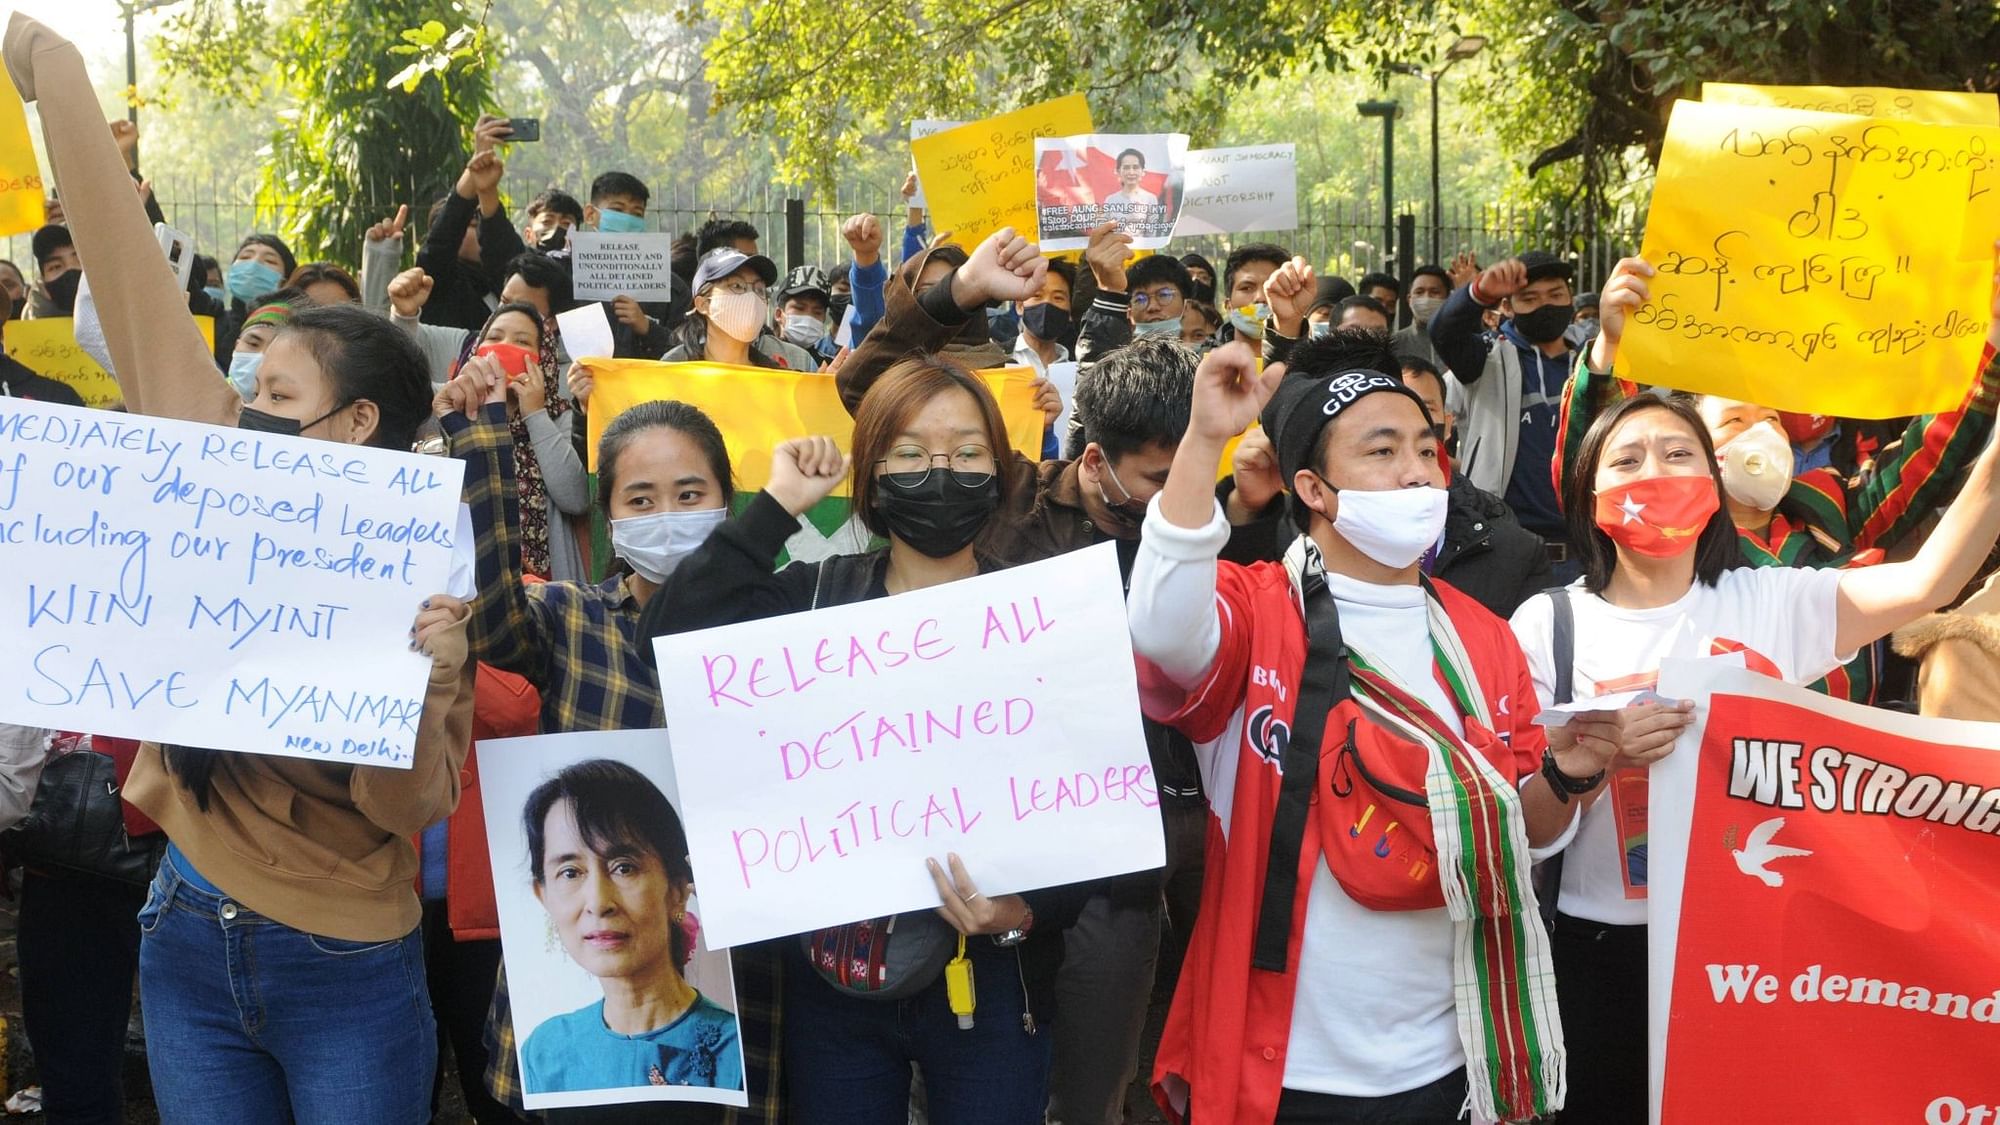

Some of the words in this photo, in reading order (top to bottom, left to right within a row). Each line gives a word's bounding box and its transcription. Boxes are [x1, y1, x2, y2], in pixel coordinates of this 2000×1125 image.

[600, 243, 640, 251] RELEASE
[577, 282, 625, 290] POLITICAL
[626, 282, 667, 290] LEADERS
[1322, 377, 1397, 415] GUCCI
[0, 453, 26, 510] f
[54, 461, 121, 495] our
[153, 467, 323, 533] deposed
[201, 433, 370, 484] RELEASE
[388, 467, 442, 495] ALL
[171, 531, 230, 561] our
[248, 531, 418, 585] president
[188, 594, 349, 650] MYINT
[702, 618, 956, 708] RELEASE
[981, 596, 1056, 649] ALL
[26, 644, 199, 710] SAVE
[225, 677, 424, 735] MYANMAR
[1730, 738, 1804, 810] WE
[1808, 745, 2000, 838] STRONG
[732, 786, 982, 889] POLITICAL
[1010, 764, 1160, 821] LEADERS
[1705, 963, 1778, 1004] We
[1790, 964, 2000, 1024] demand
[1925, 1096, 2000, 1125] Ot
